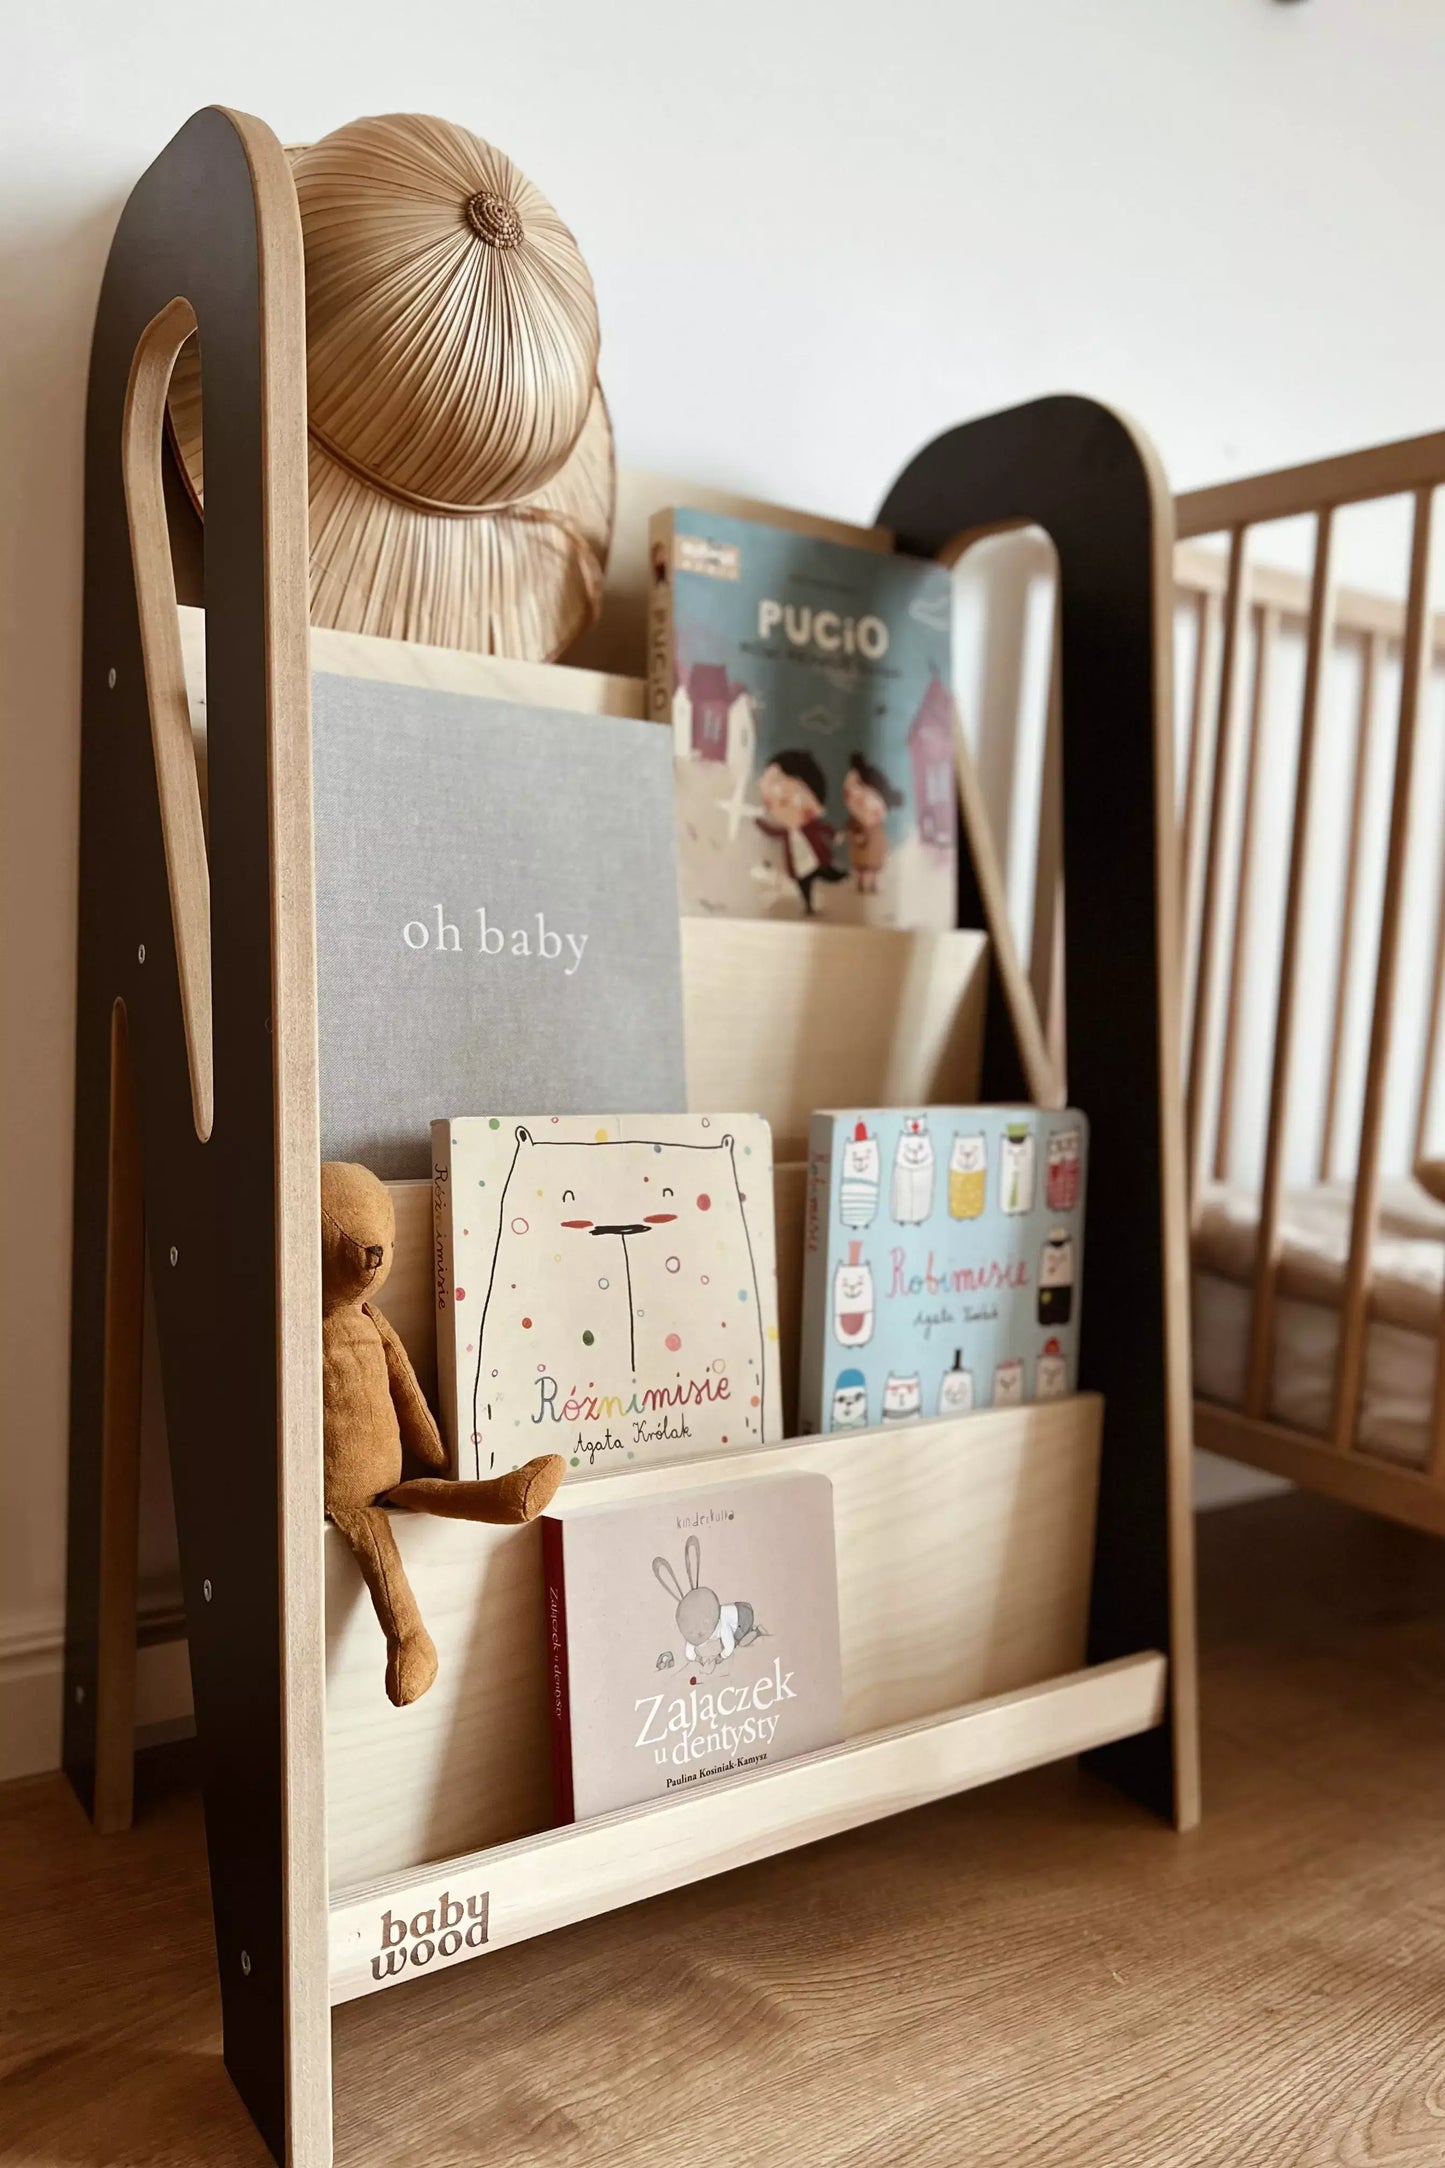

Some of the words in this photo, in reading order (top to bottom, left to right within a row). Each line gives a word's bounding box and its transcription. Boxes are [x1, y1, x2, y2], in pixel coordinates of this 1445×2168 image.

[403, 903, 463, 951] oh
[476, 907, 589, 975] baby
[531, 1366, 731, 1424] Różnimisie
[574, 1428, 624, 1464] Agata
[633, 1413, 692, 1443] Królak
[634, 1657, 797, 1748] Zajączek
[654, 1746, 668, 1765] u
[666, 1771, 697, 1788] Paulina
[699, 1752, 768, 1779] Kosiniak-Kamysz
[370, 1915, 490, 1980] wood
[380, 1891, 490, 1950] baby
